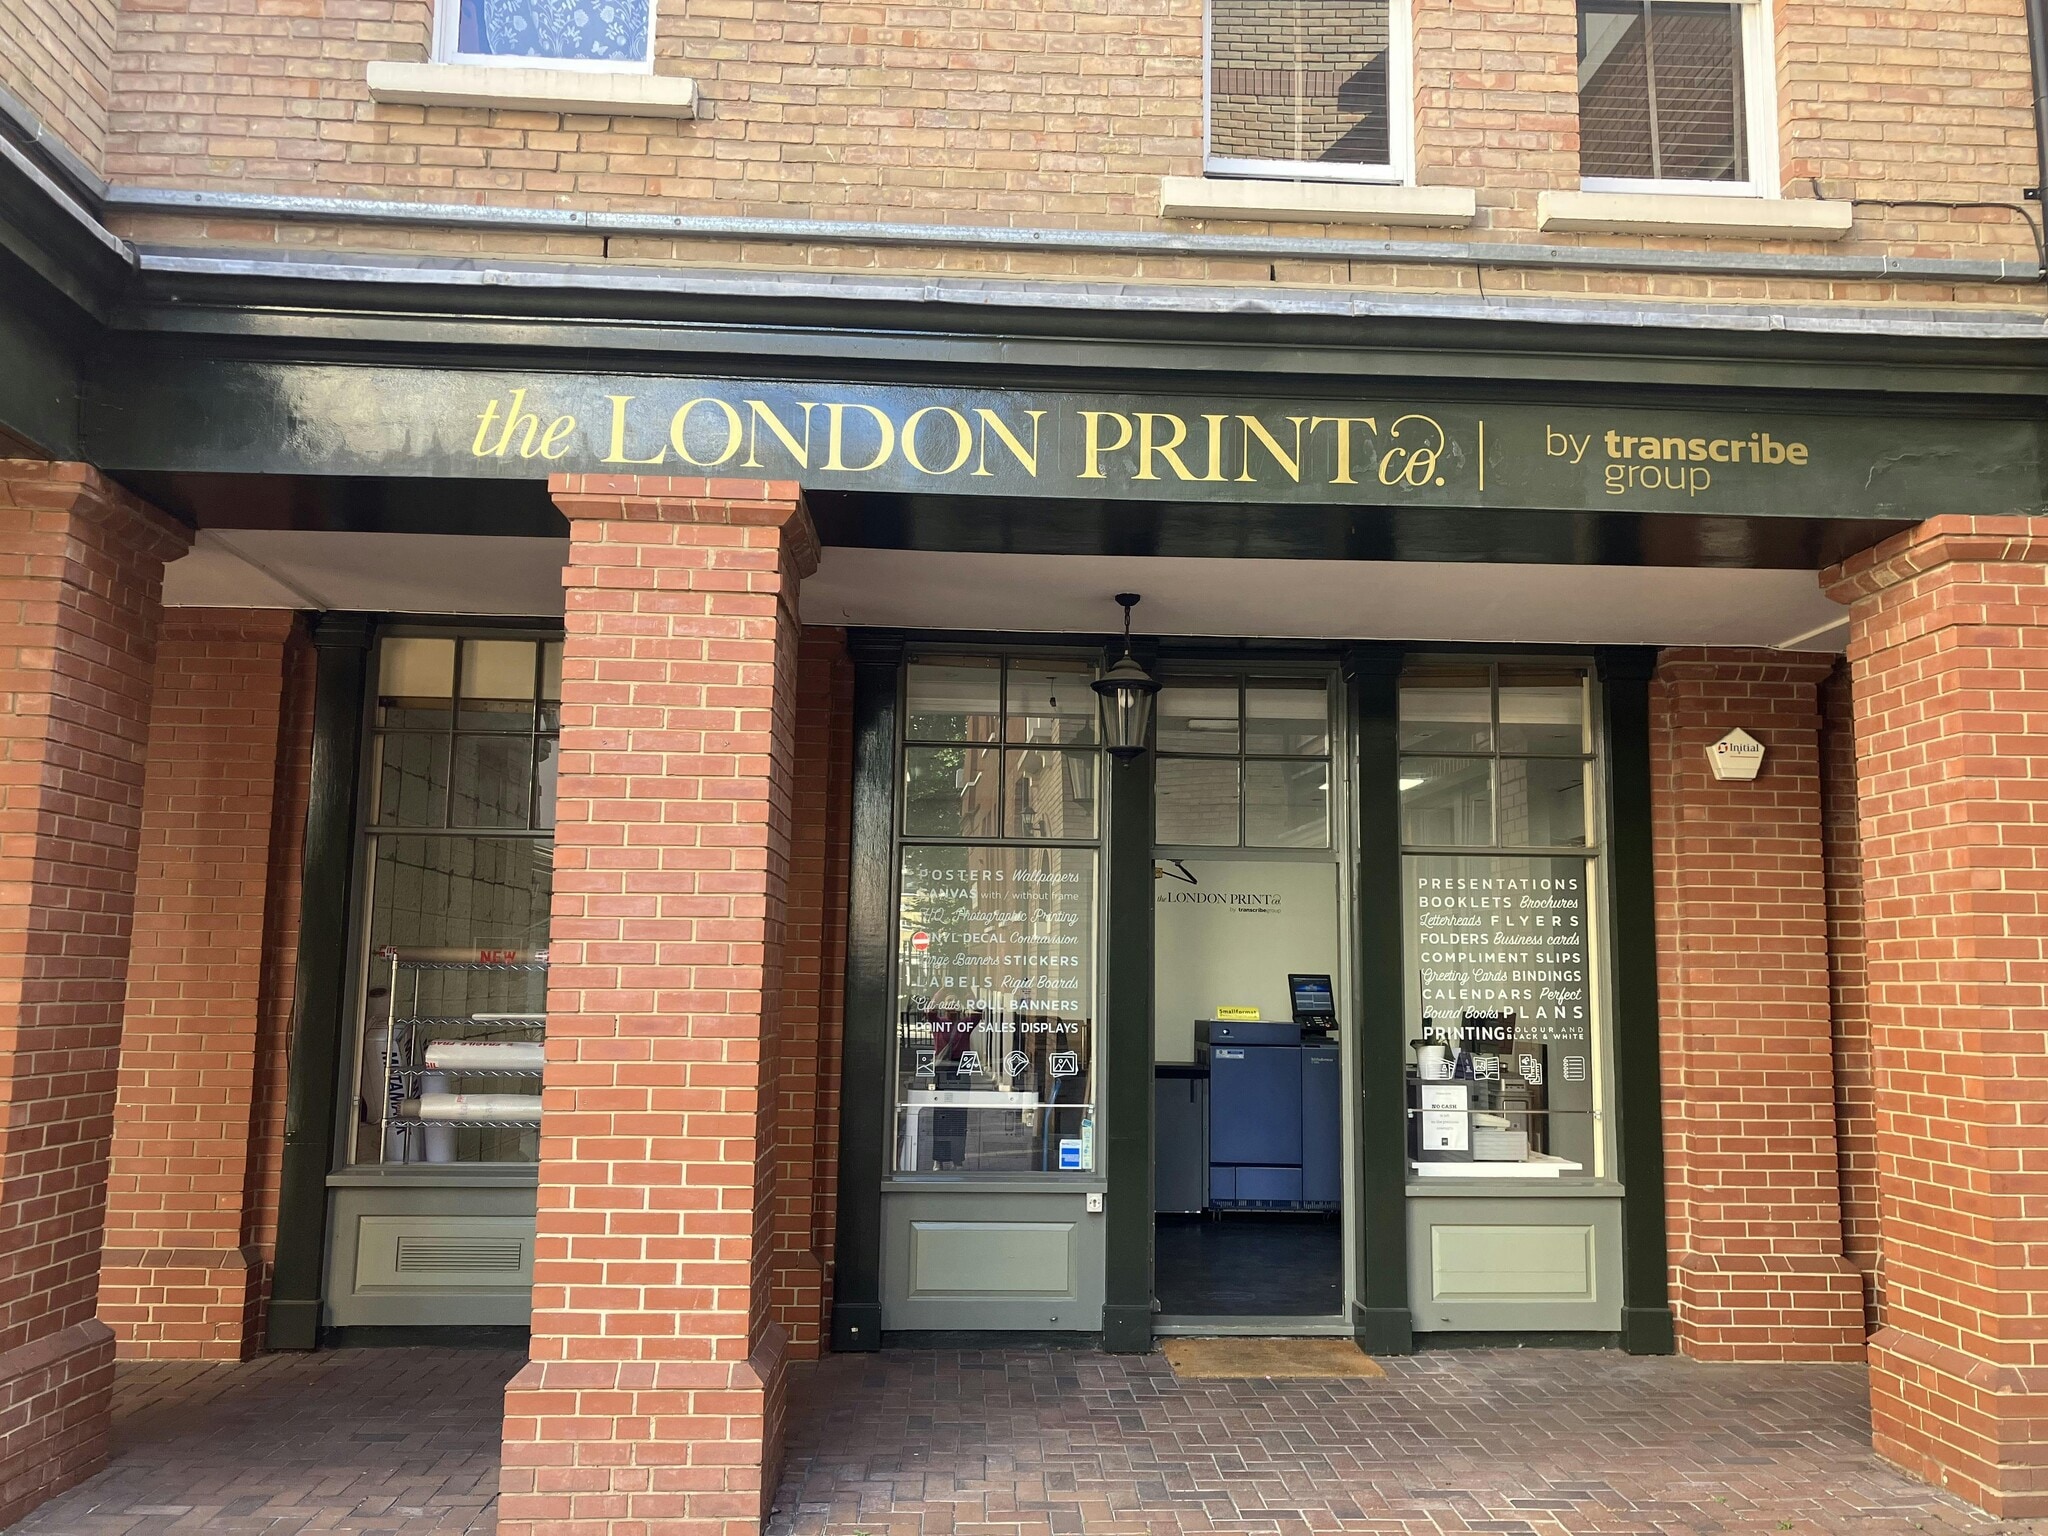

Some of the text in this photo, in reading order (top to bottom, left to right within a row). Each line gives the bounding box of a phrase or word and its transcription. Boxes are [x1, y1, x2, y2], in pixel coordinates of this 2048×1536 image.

[471, 388, 1445, 486] the LONDON PRINT co.
[1546, 424, 1809, 465] by transcribe
[1604, 463, 1711, 497] group
[1730, 743, 1759, 752] Initial
[919, 869, 1079, 883] POSTERS Wallpapers
[1418, 878, 1578, 890] PRESENTATIONS
[980, 891, 1001, 900] with
[1011, 891, 1050, 900] without
[1052, 891, 1079, 901] frame
[1167, 892, 1227, 904] LONDON
[1230, 893, 1272, 905] PRINT
[1419, 895, 1578, 909] BOOKLETS Brochures
[951, 906, 1027, 926] Photographic
[1030, 908, 1079, 927] Printing
[1419, 914, 1579, 929] Letterheads FLYERS
[963, 932, 1006, 944] DECAL
[1420, 932, 1580, 946] FOLDERS Business cards
[952, 953, 1000, 967] Banners
[1003, 955, 1079, 966] STICKERS
[1421, 952, 1581, 964] COMPLIMENT SLIPS
[1422, 968, 1581, 986] Greeting Cards BINDINGS
[916, 975, 1079, 994] LABELS Rigid Boards
[1422, 987, 1582, 1005] CALENDARS Perfect
[966, 999, 1004, 1011] ROLL
[1010, 999, 1079, 1011] BANNERS
[1423, 1006, 1584, 1019] Bound Books PLANS
[915, 1022, 1079, 1033] POINT OF SALES DISPLAYS
[1423, 1026, 1505, 1041] PRINTING
